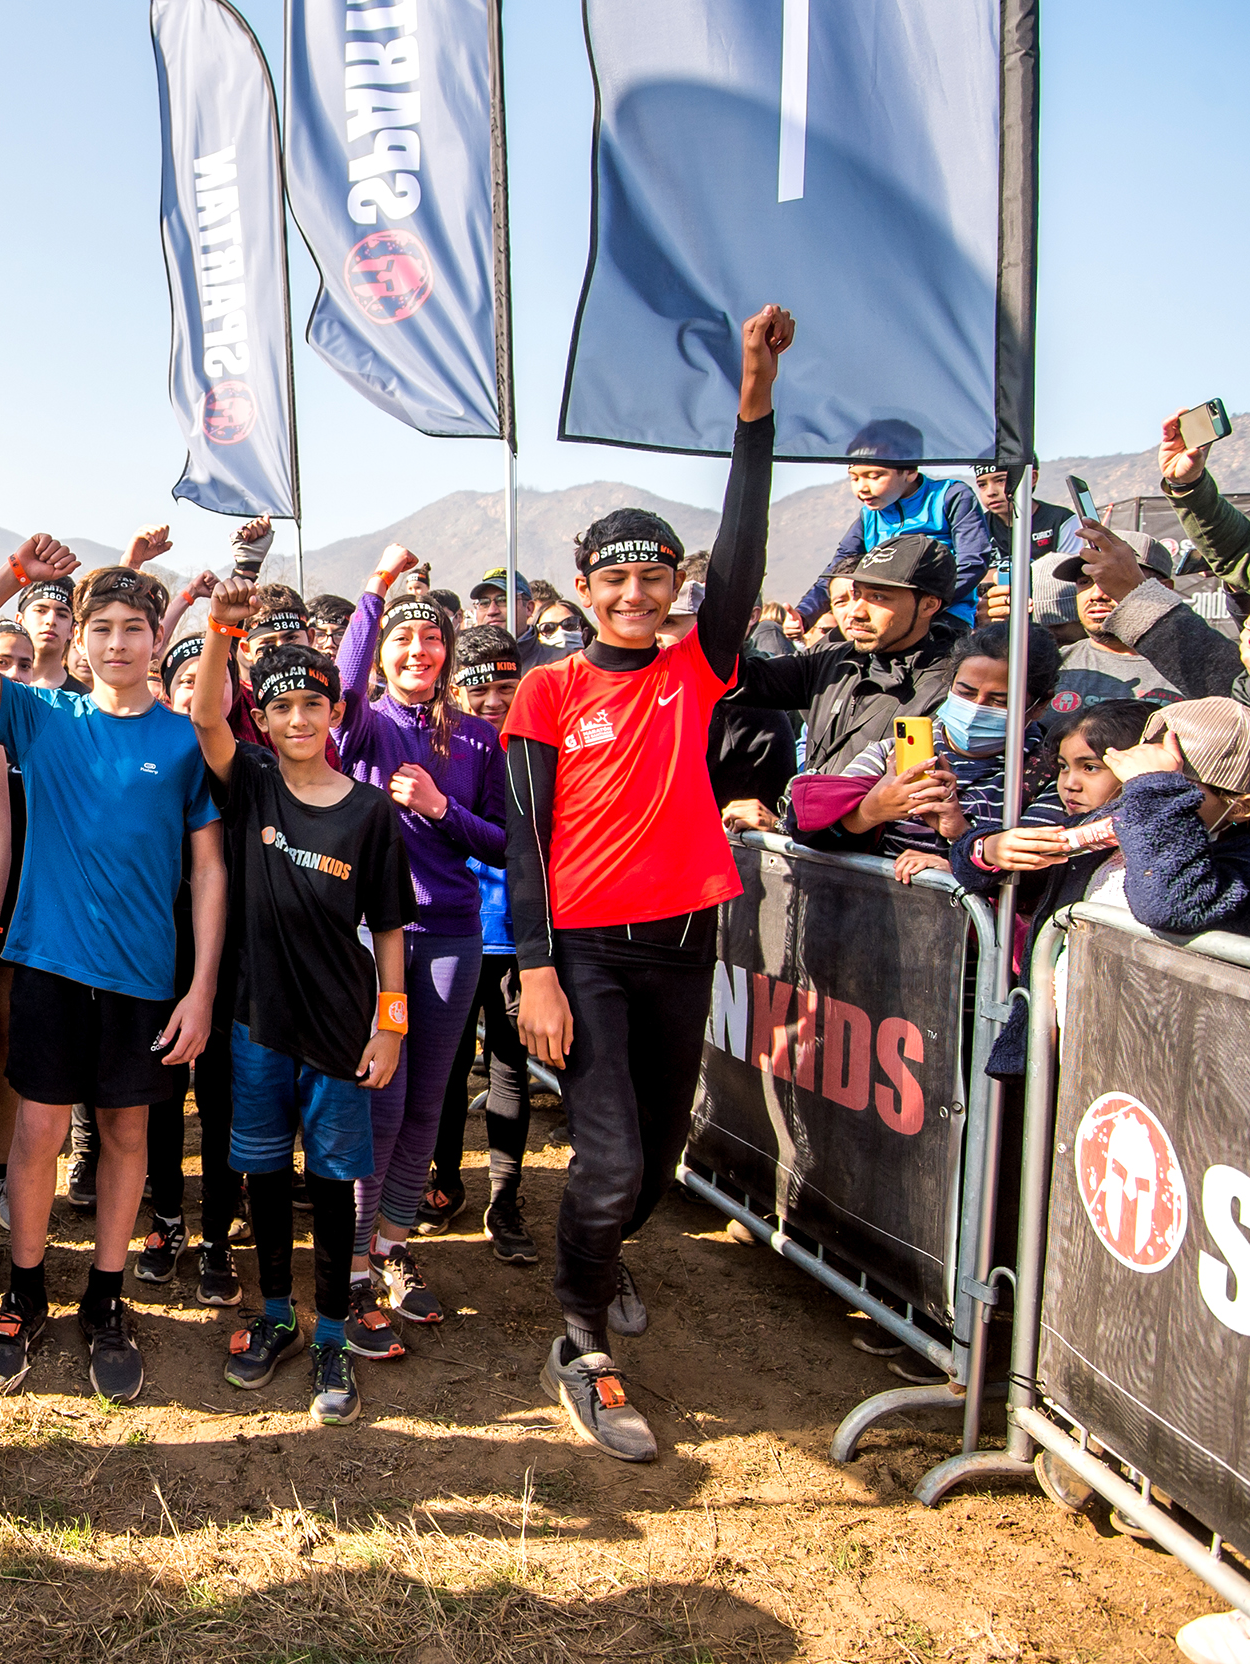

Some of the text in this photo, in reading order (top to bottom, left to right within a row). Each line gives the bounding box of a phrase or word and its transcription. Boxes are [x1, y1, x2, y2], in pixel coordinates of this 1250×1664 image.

[600, 540, 659, 559] SPARTAN
[616, 551, 659, 564] 3552
[42, 591, 68, 605] 3602
[387, 602, 435, 619] SPARTA
[403, 610, 437, 624] 3802
[273, 621, 300, 631] 3849
[496, 662, 517, 671] KIDS
[308, 667, 330, 687] KIDS
[465, 674, 494, 687] 3511
[272, 677, 306, 697] 3514
